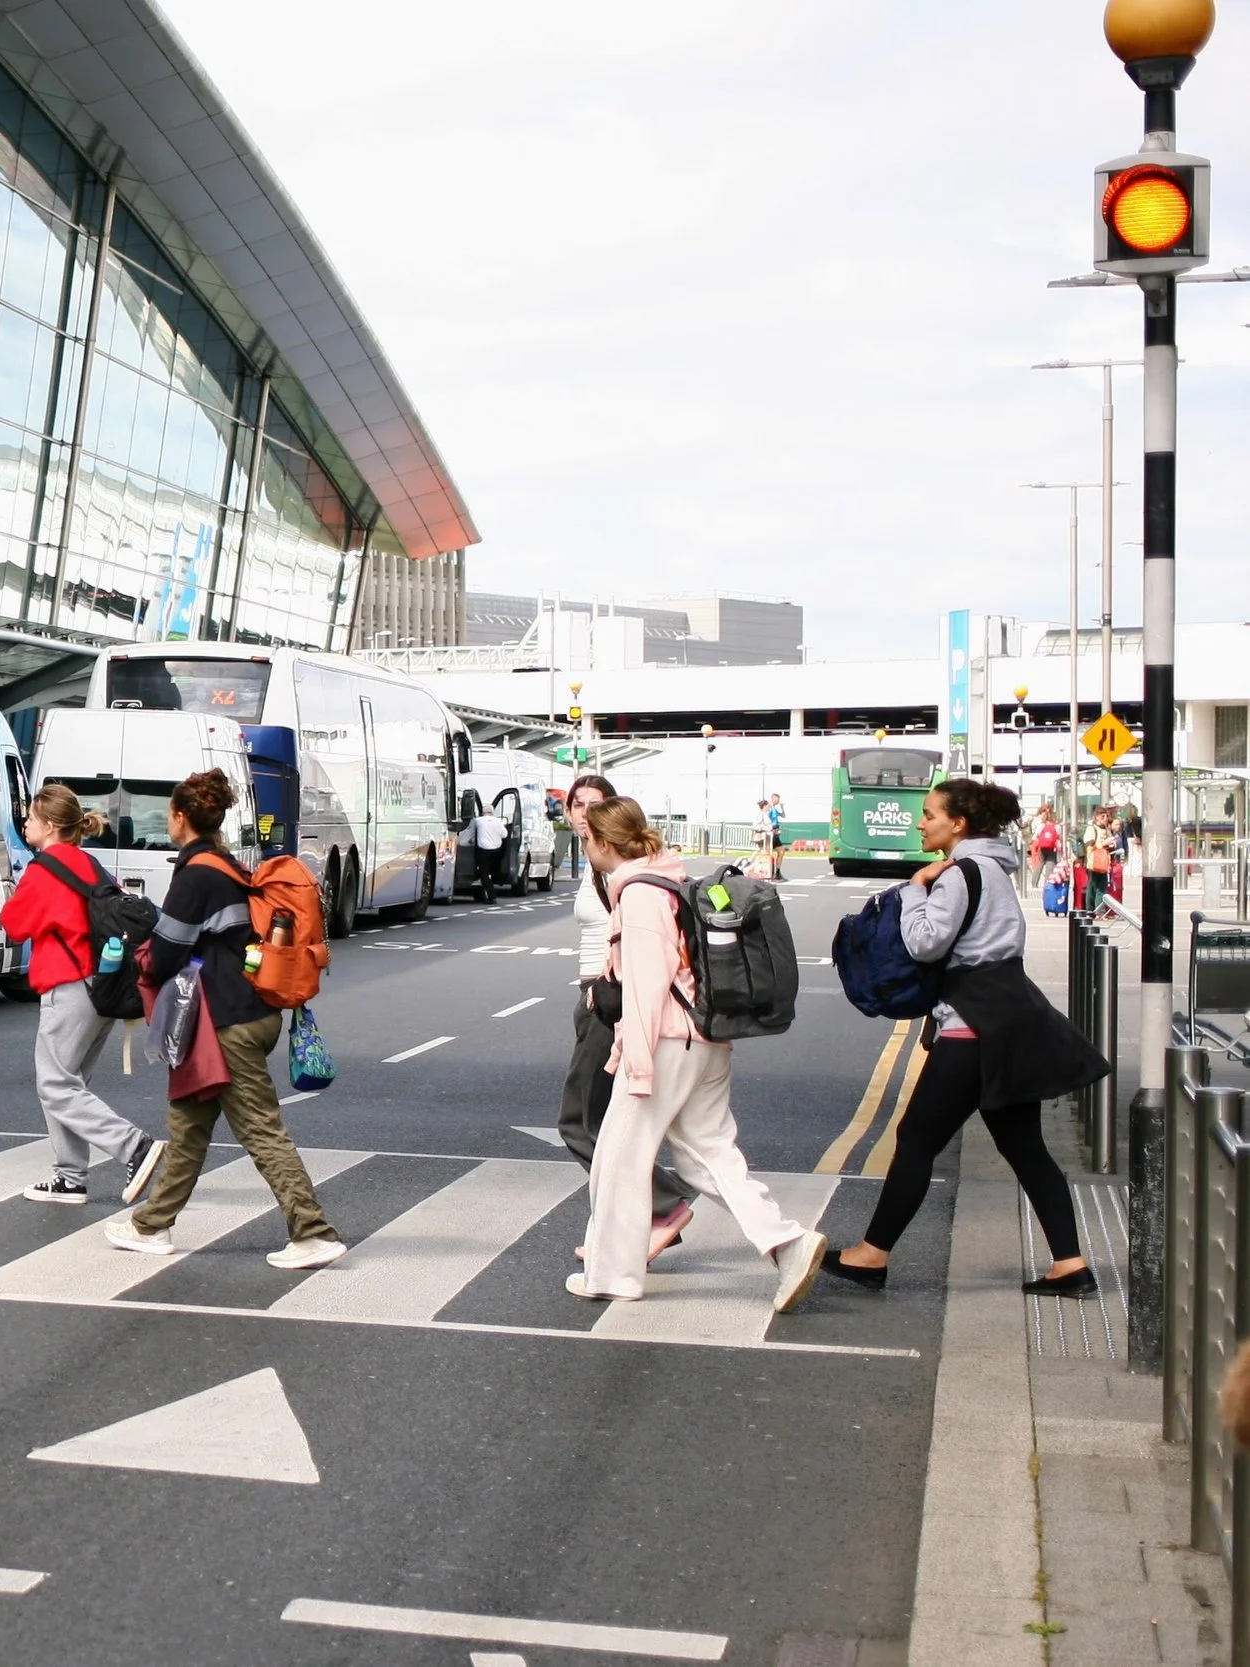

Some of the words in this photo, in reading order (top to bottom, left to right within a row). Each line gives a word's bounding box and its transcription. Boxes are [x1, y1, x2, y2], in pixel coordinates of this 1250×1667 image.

[952, 648, 965, 685] P
[956, 751, 966, 770] A
[877, 801, 900, 812] CAR
[863, 811, 913, 825] PARKS
